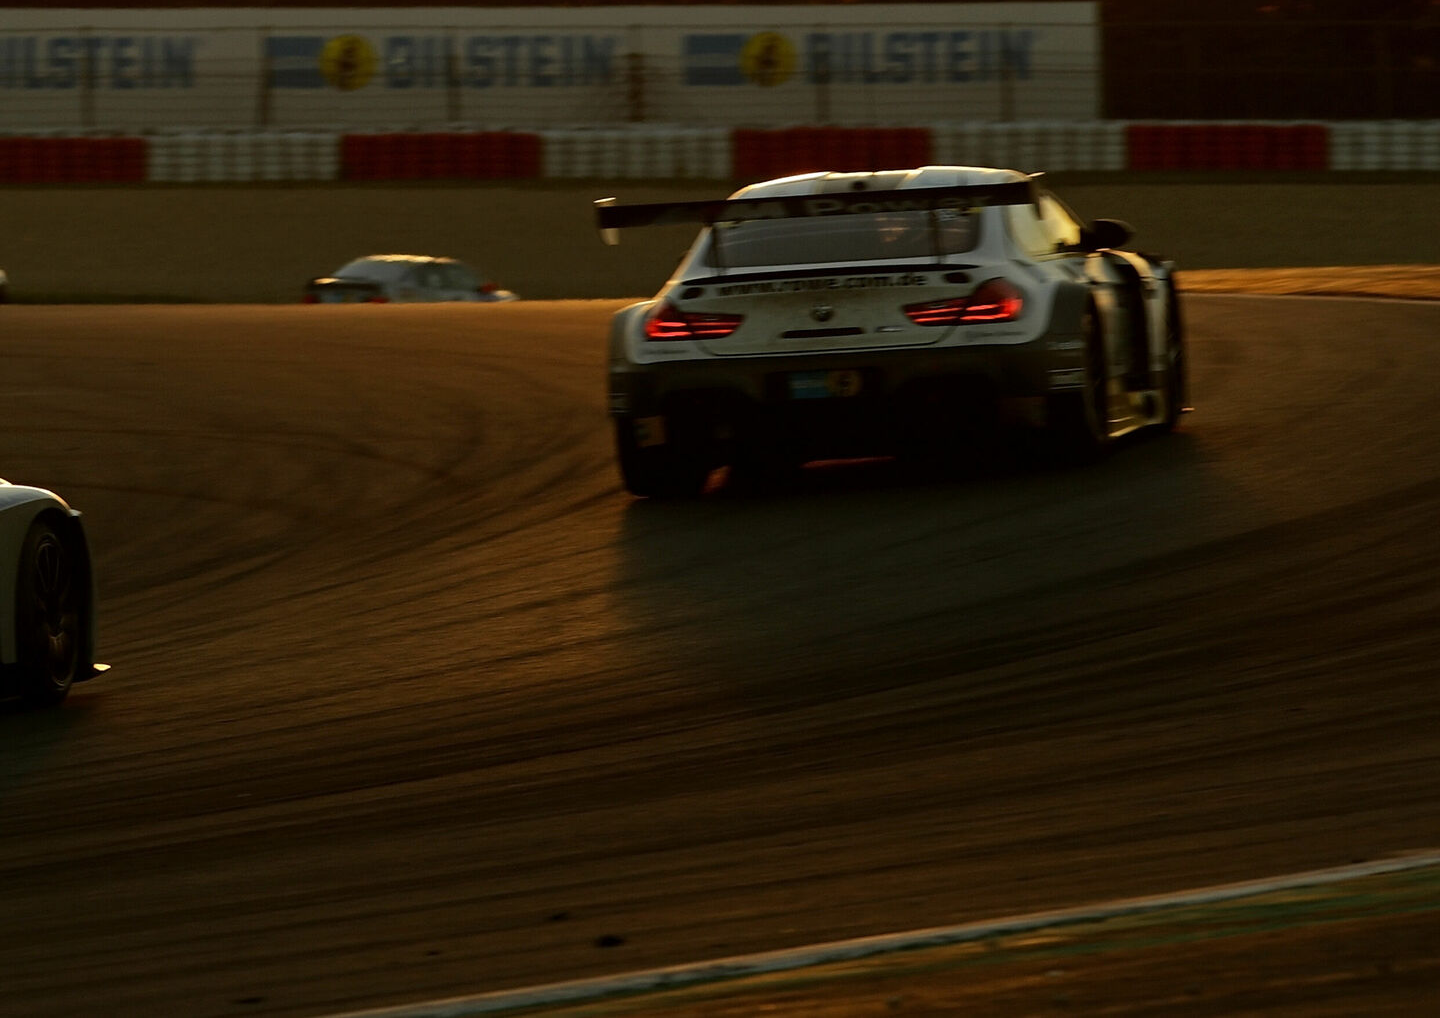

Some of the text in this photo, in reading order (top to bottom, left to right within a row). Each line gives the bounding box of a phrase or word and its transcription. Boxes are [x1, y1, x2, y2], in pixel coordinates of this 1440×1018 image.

[385, 35, 616, 89] BILSTEIN
[805, 32, 1036, 84] BILSTEIN
[813, 194, 994, 214] Power
